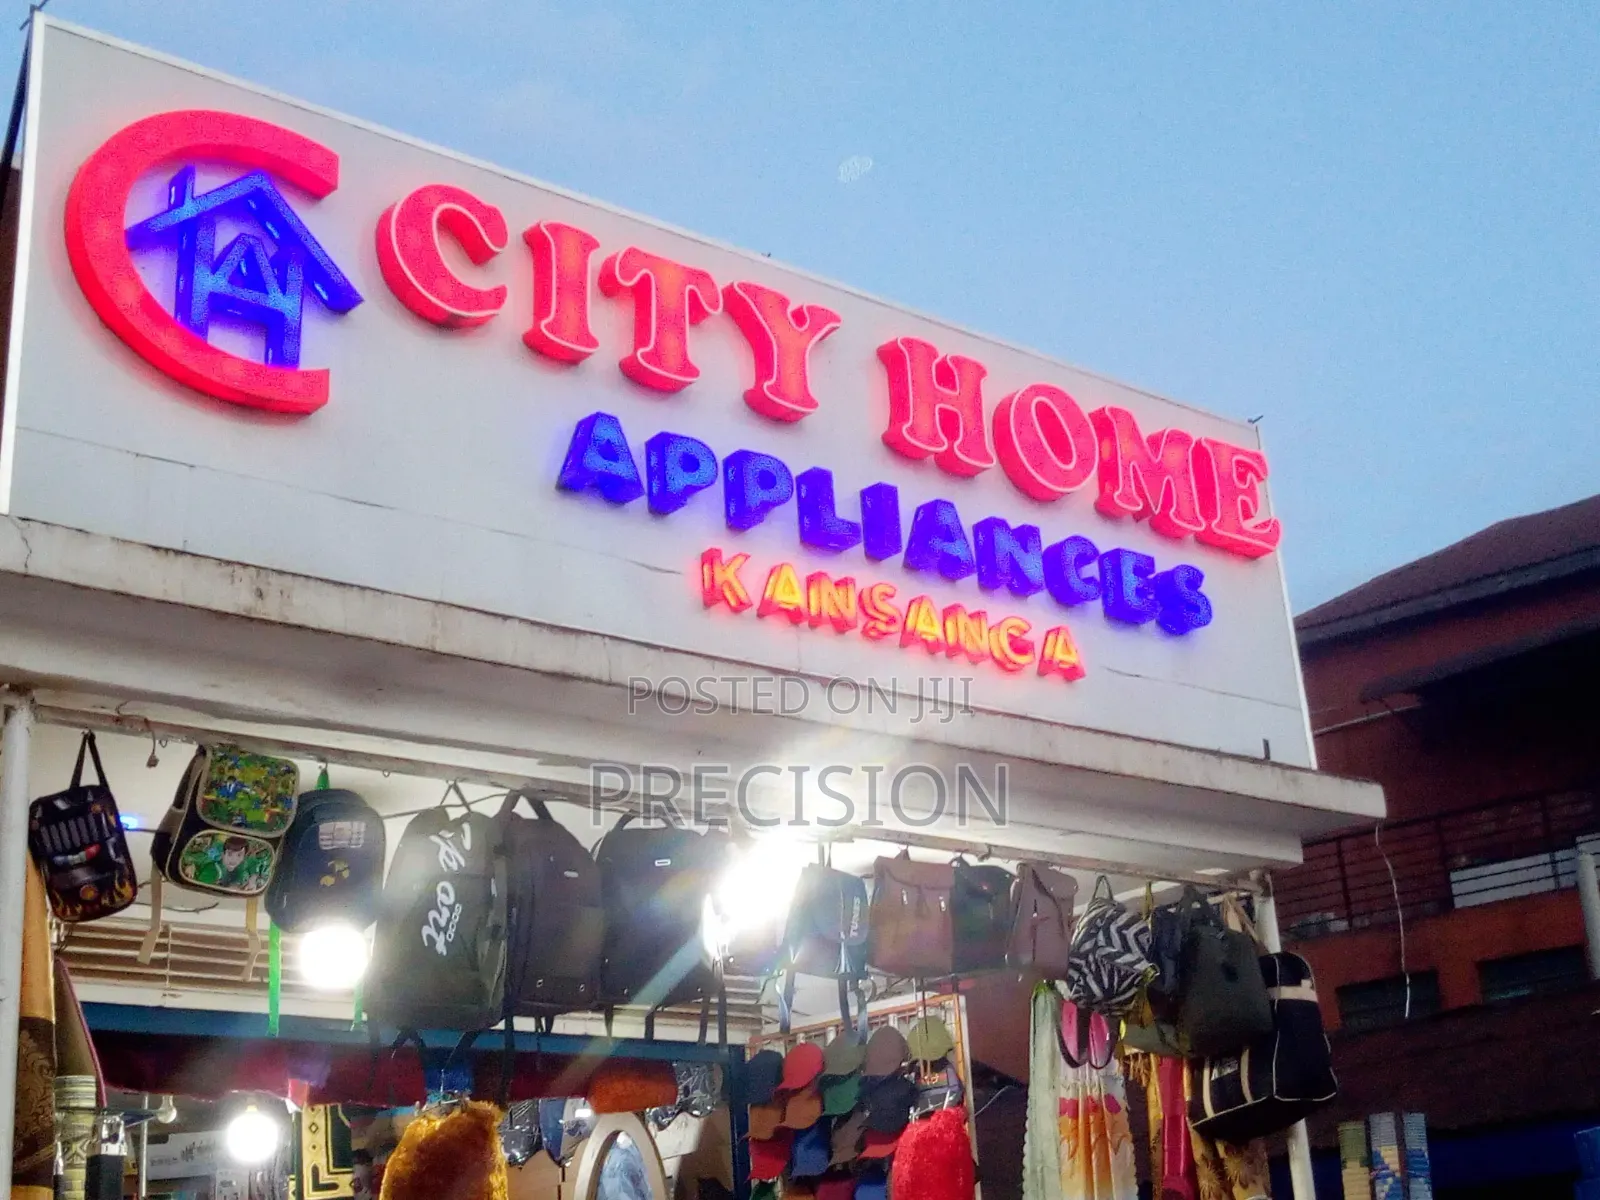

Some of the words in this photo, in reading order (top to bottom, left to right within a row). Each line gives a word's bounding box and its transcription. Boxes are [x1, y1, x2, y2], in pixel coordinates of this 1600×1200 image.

[376, 184, 841, 423] CITY
[876, 336, 1281, 559] HOME
[555, 411, 1214, 636] APPLIANCES
[700, 547, 1087, 683] KANSANGA
